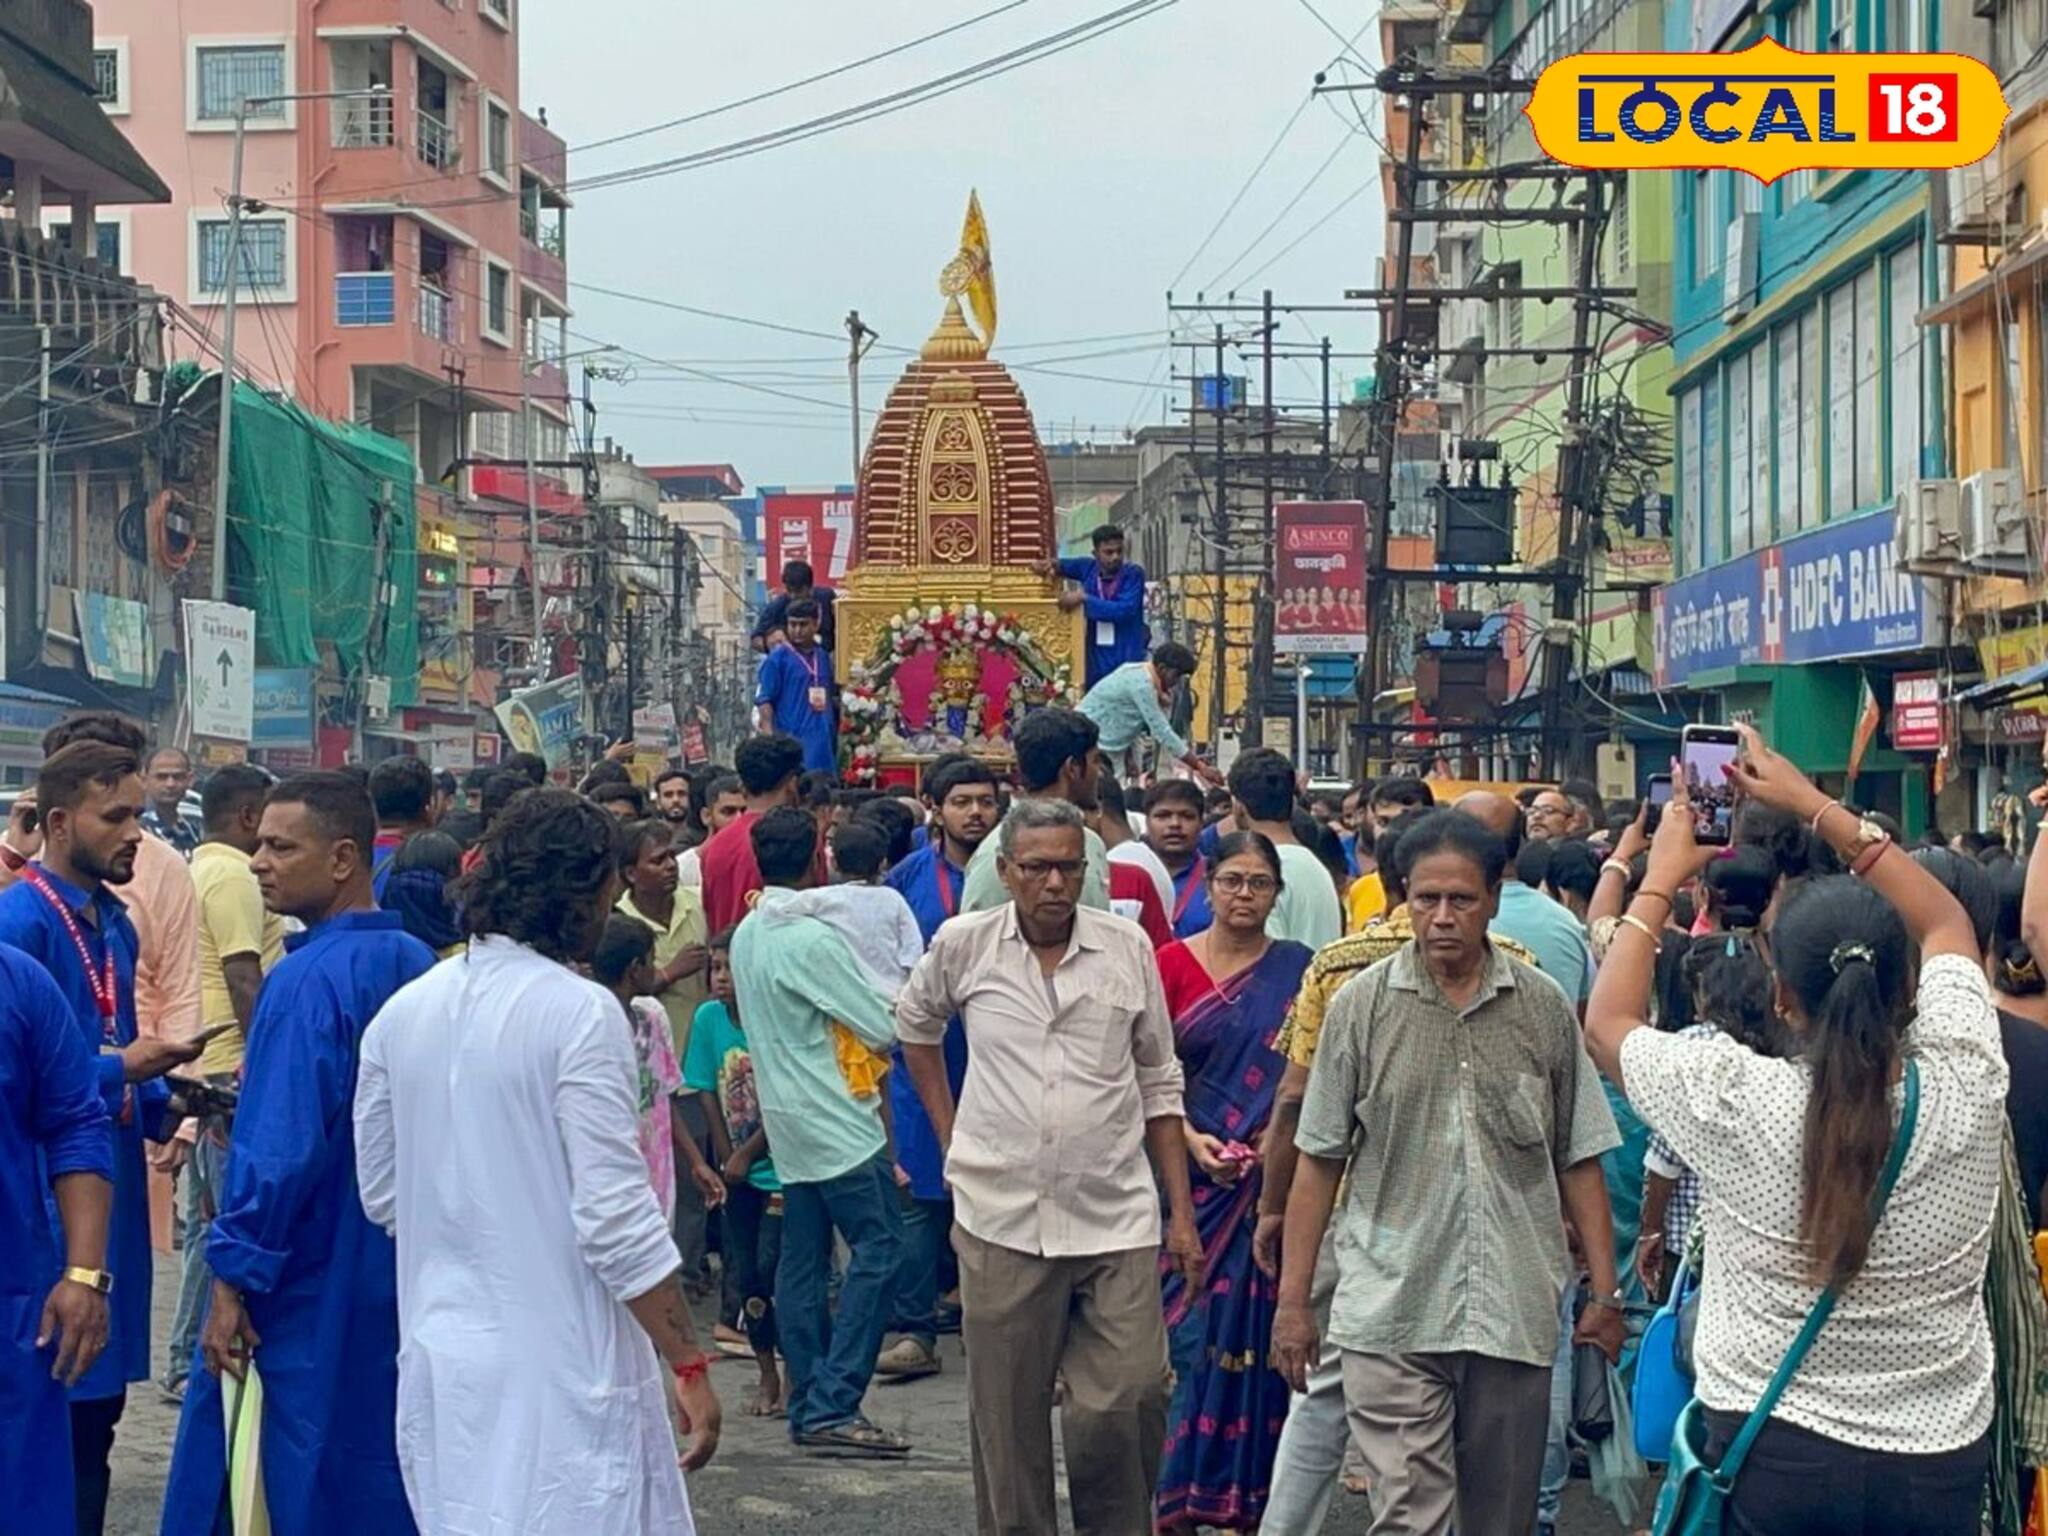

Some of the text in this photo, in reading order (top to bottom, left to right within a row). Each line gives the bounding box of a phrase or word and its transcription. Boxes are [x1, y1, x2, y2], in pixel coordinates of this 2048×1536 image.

[822, 500, 854, 516] FLAT
[1301, 529, 1348, 542] SENCO
[1790, 553, 1843, 633] HDFC
